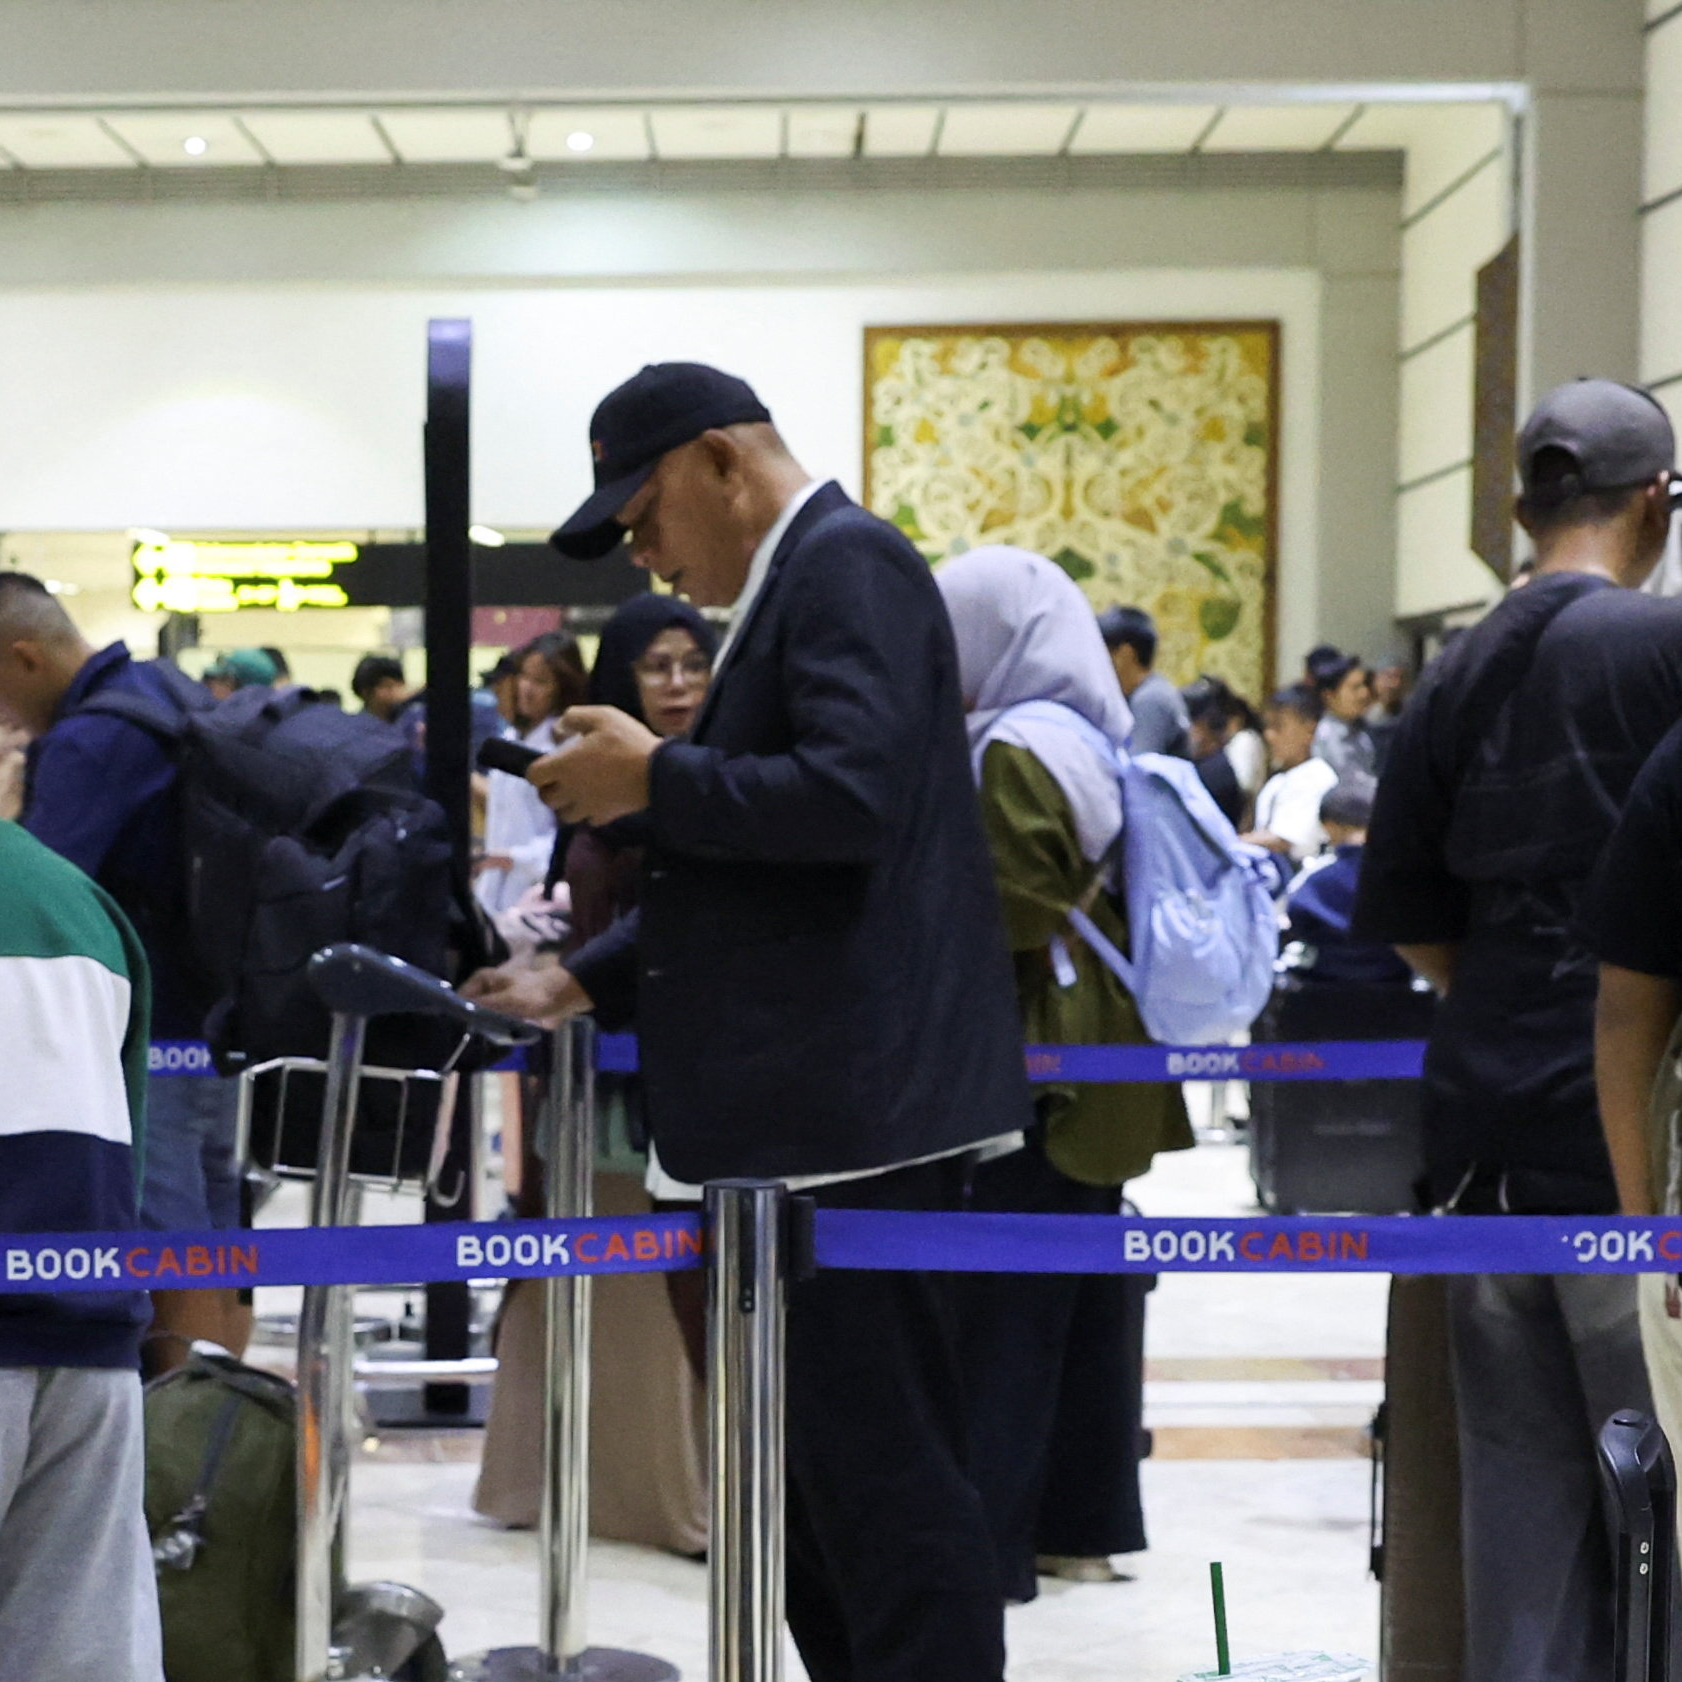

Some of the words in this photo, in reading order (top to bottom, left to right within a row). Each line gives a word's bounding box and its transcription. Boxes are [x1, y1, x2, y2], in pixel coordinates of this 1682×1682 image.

[6, 1246, 258, 1281] BOOKCABIN
[456, 1228, 704, 1268] BOOKCABIN
[1124, 1230, 1368, 1262] BOOKCABIN
